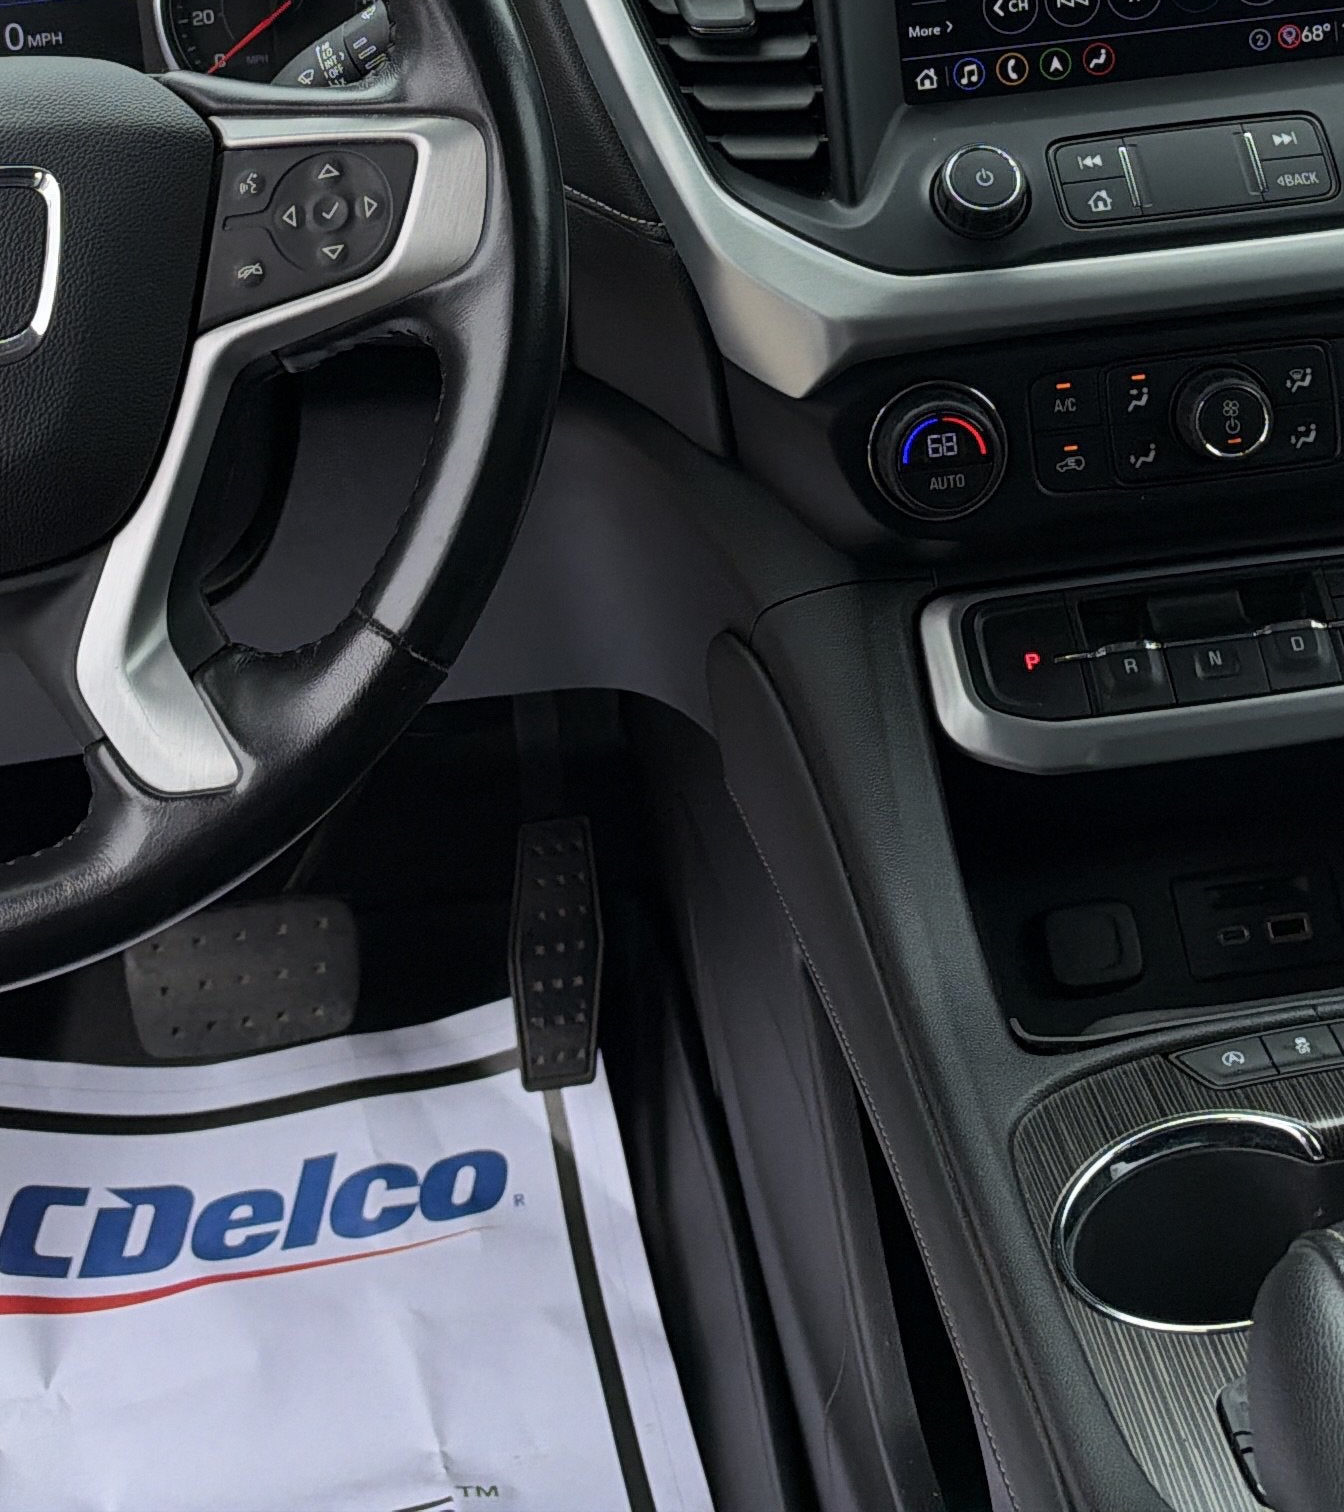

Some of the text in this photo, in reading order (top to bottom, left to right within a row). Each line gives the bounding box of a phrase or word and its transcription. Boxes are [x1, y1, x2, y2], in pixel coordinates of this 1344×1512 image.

[1008, 0, 1029, 13] CH
[192, 10, 215, 26] 20
[4, 23, 63, 51] 0 MPH
[908, 25, 941, 39] More
[1284, 171, 1320, 186] BACK
[1053, 398, 1077, 414] A/C
[927, 432, 957, 458] 68
[929, 474, 966, 491] AUTO
[1290, 636, 1305, 653] D
[1024, 651, 1040, 671] P
[1124, 658, 1139, 675] R
[1208, 650, 1223, 667] N
[454, 1485, 500, 1498] TM
